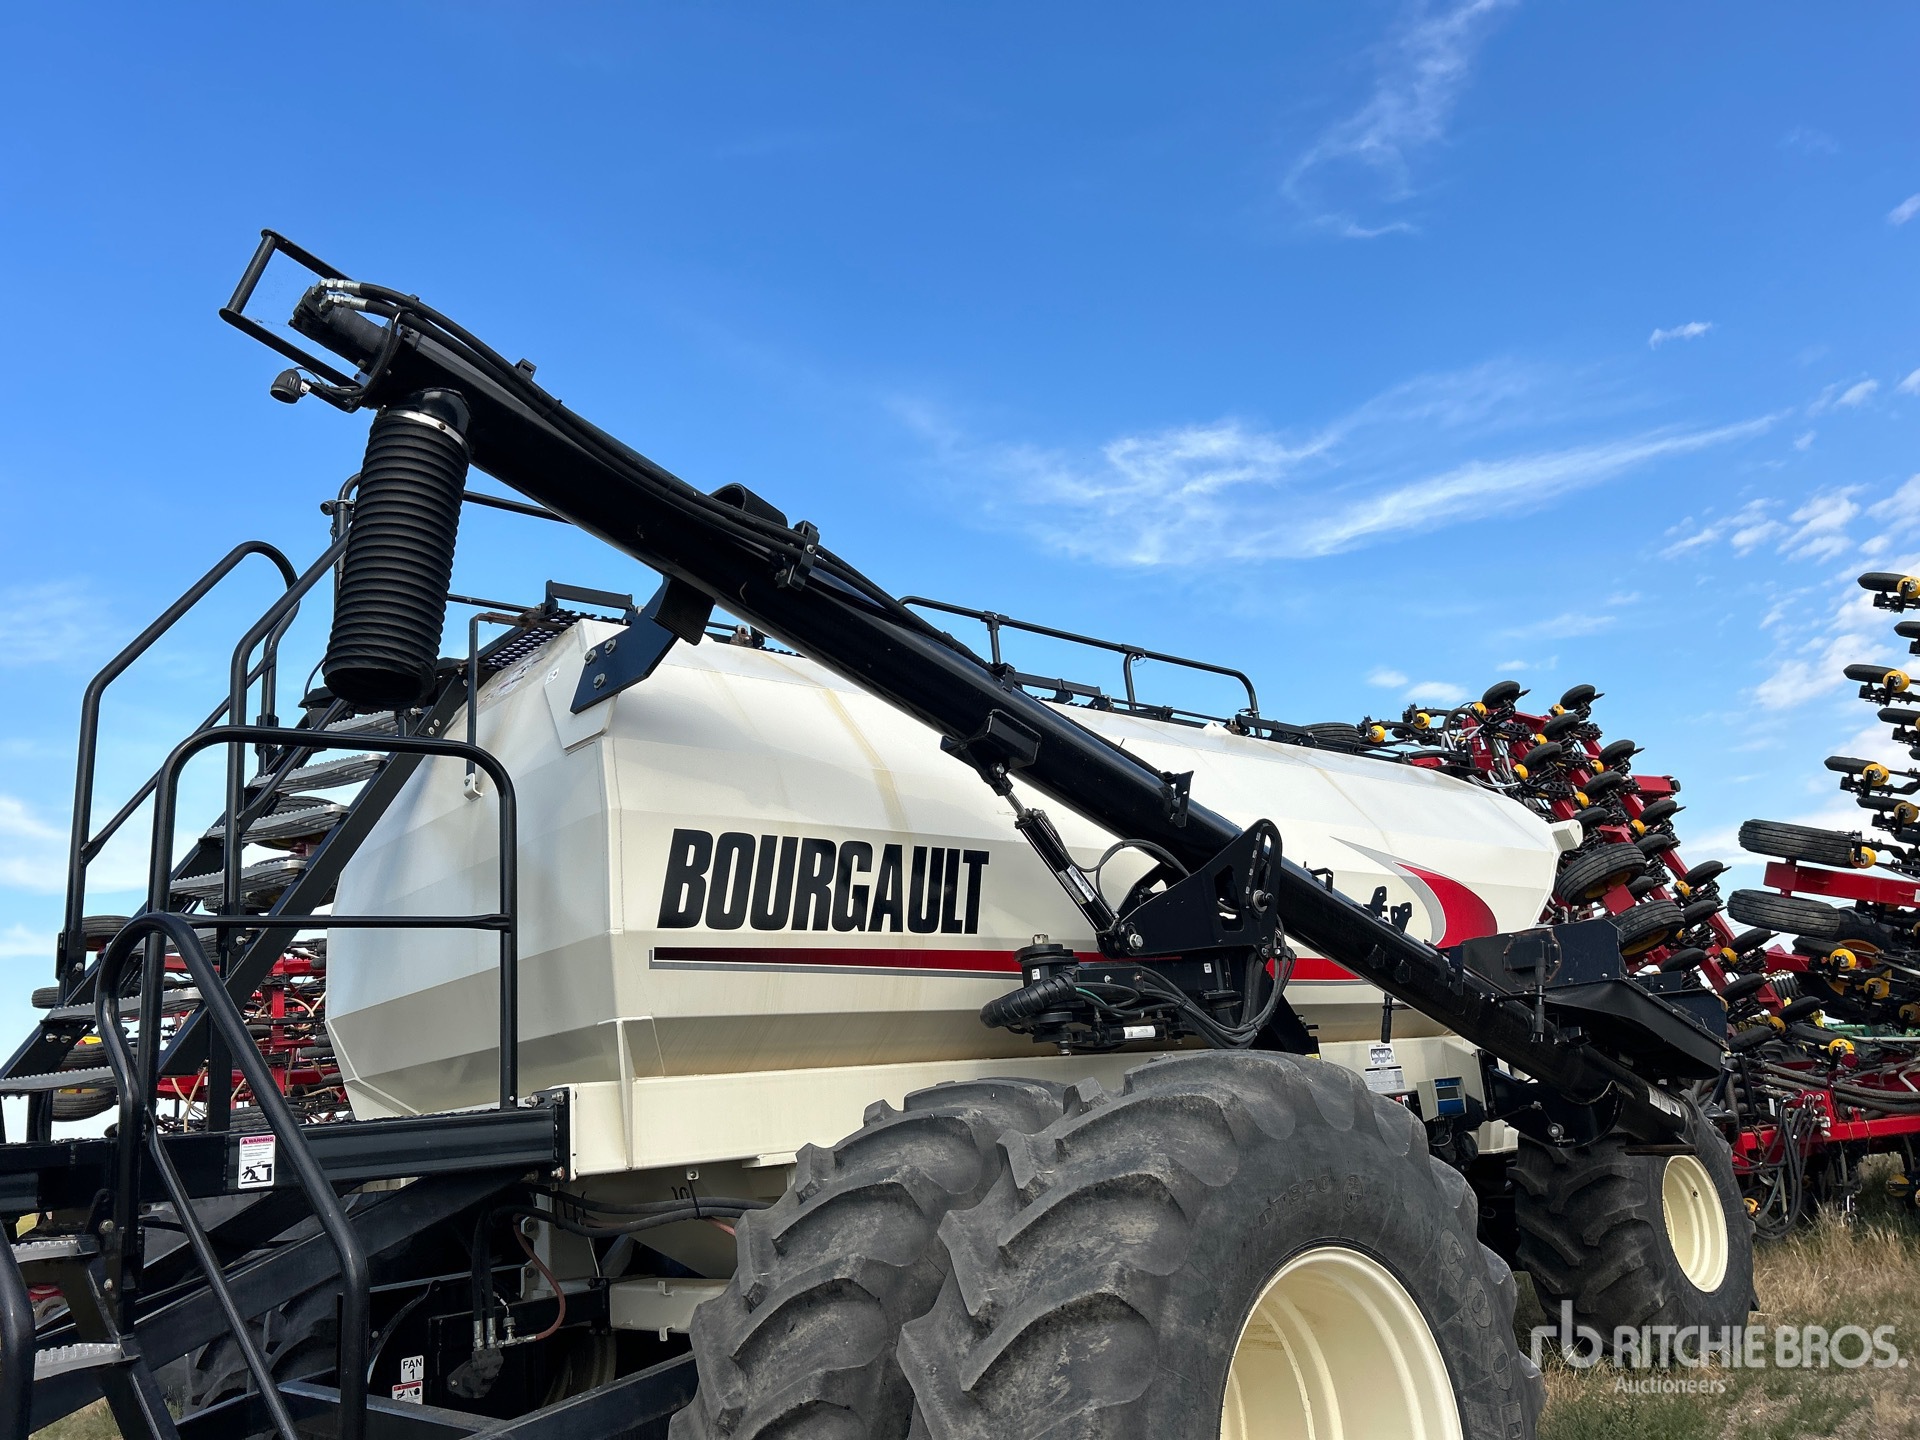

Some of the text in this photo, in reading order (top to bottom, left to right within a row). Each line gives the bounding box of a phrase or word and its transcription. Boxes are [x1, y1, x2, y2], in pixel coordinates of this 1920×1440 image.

[657, 828, 990, 935] BOURGAULT
[248, 1136, 274, 1144] WARNING
[402, 1358, 423, 1370] FAN
[409, 1368, 415, 1379] 1
